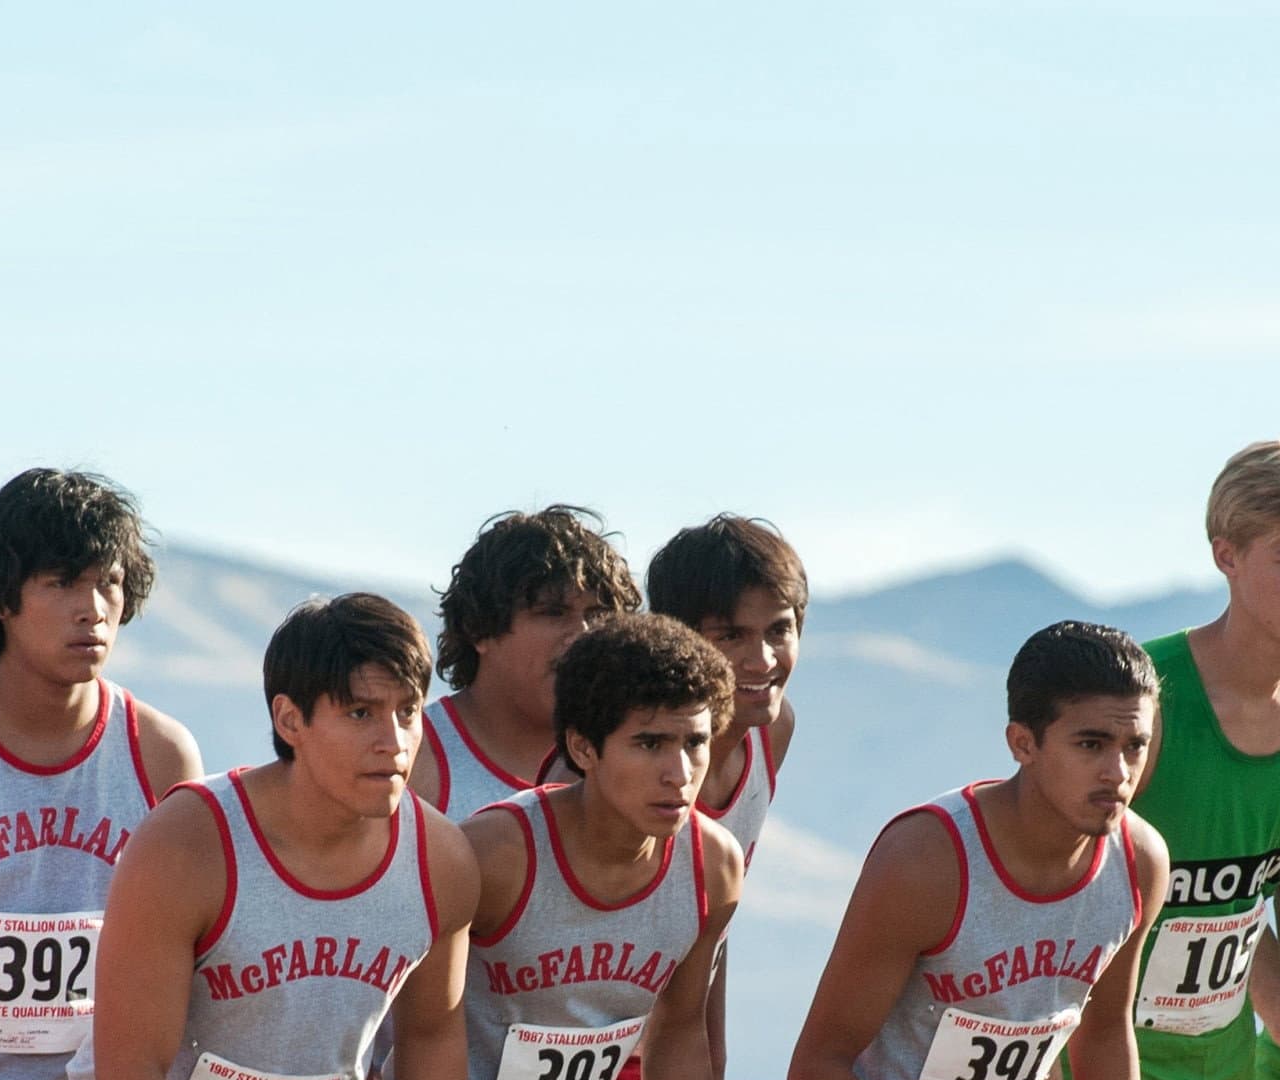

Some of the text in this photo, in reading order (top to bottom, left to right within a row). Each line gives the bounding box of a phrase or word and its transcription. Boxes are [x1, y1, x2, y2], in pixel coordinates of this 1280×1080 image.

[1165, 864, 1242, 903] ALO
[4, 919, 56, 932] STALLION
[58, 920, 76, 932] OAK
[1170, 921, 1194, 933] 1987
[1195, 919, 1239, 933] STALLION
[199, 936, 413, 1001] McFARLAN
[923, 938, 1103, 1003] McFARLA
[12, 1004, 74, 1018] QUALIFYING
[1154, 996, 1185, 1007] STATE
[518, 1023, 642, 1046] 1987 STALLION OAK RANCH
[955, 1015, 981, 1031] 1987
[981, 1022, 1029, 1037] STALLION
[209, 1061, 235, 1080] 1987
